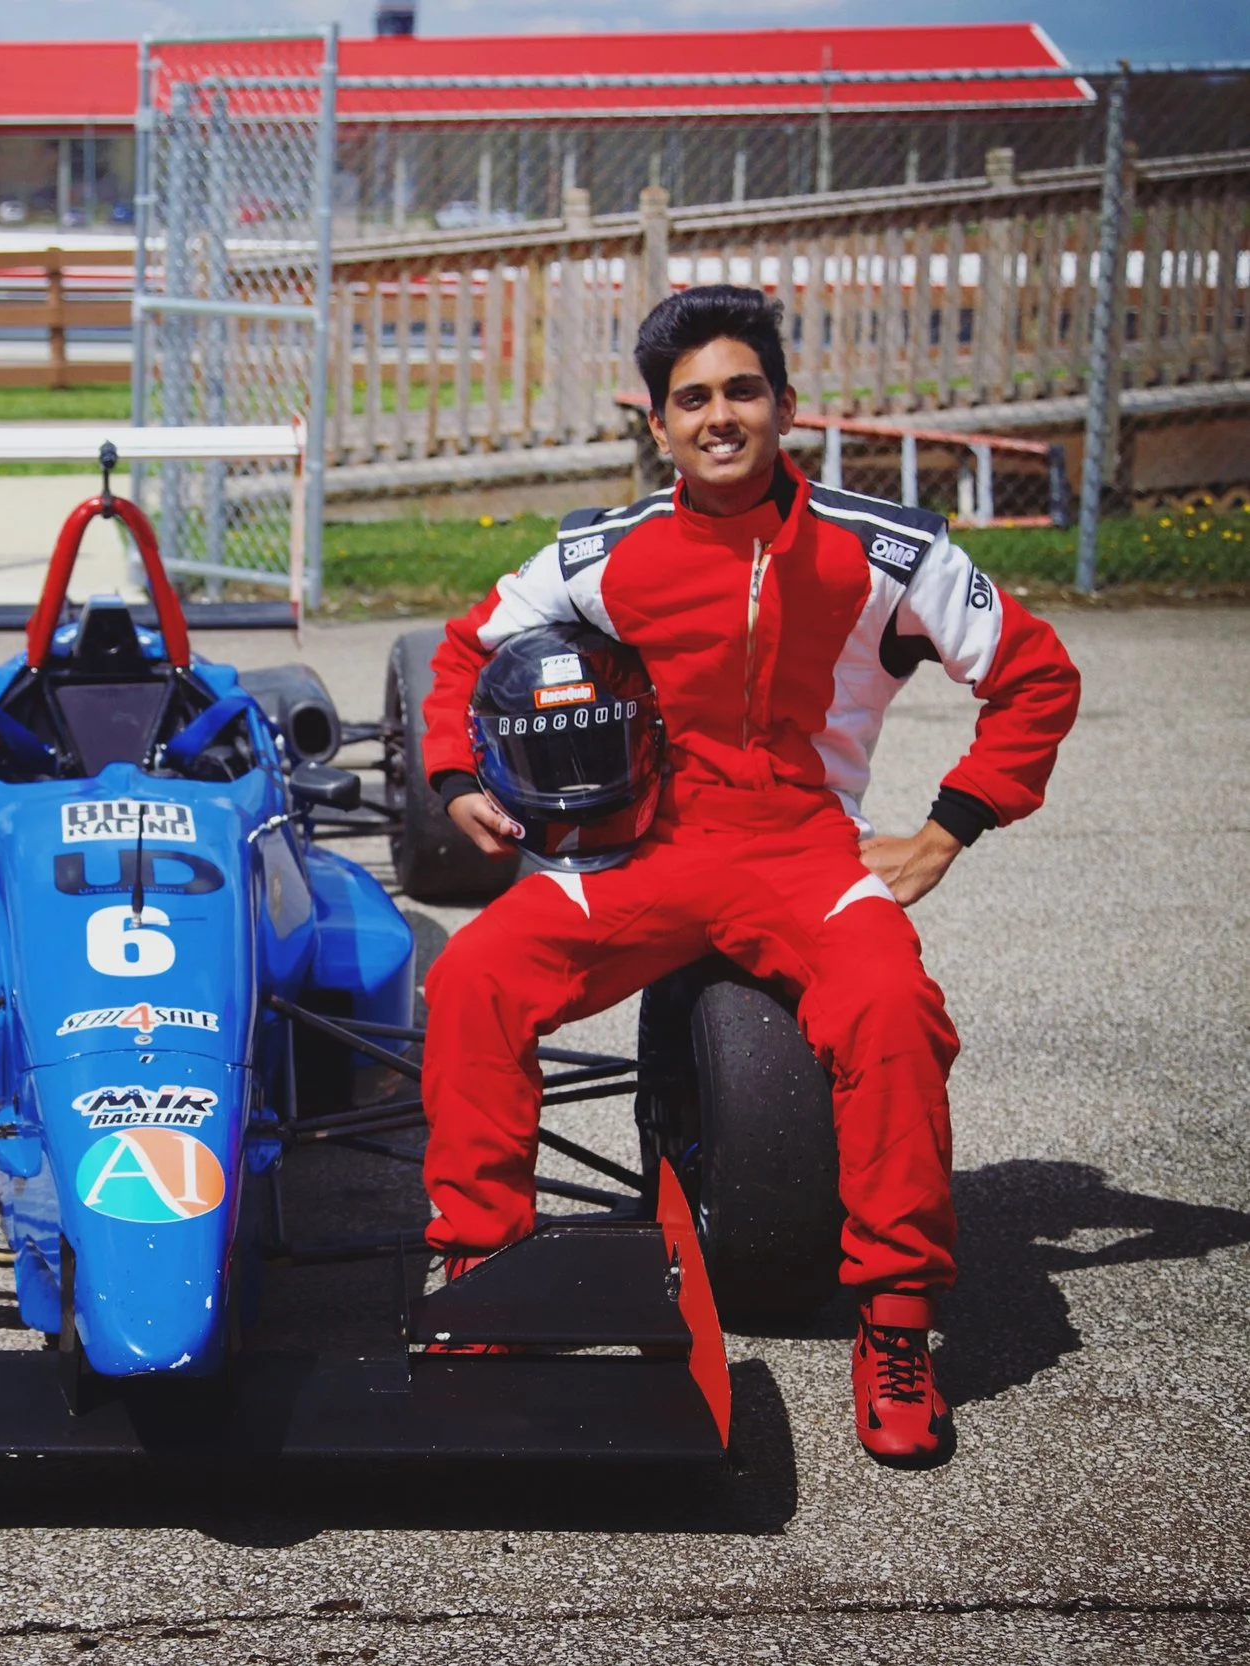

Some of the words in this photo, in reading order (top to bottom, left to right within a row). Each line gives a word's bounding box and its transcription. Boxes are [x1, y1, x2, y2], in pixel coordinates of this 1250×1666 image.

[563, 537, 605, 561] OMP
[871, 538, 916, 566] OMP
[970, 572, 989, 609] OM
[498, 700, 638, 736] RaceQuip
[68, 818, 191, 837] RACNG
[53, 848, 226, 896] UD
[86, 904, 176, 977] 6
[93, 1112, 201, 1126] RACELINE
[83, 1133, 209, 1219] AI
